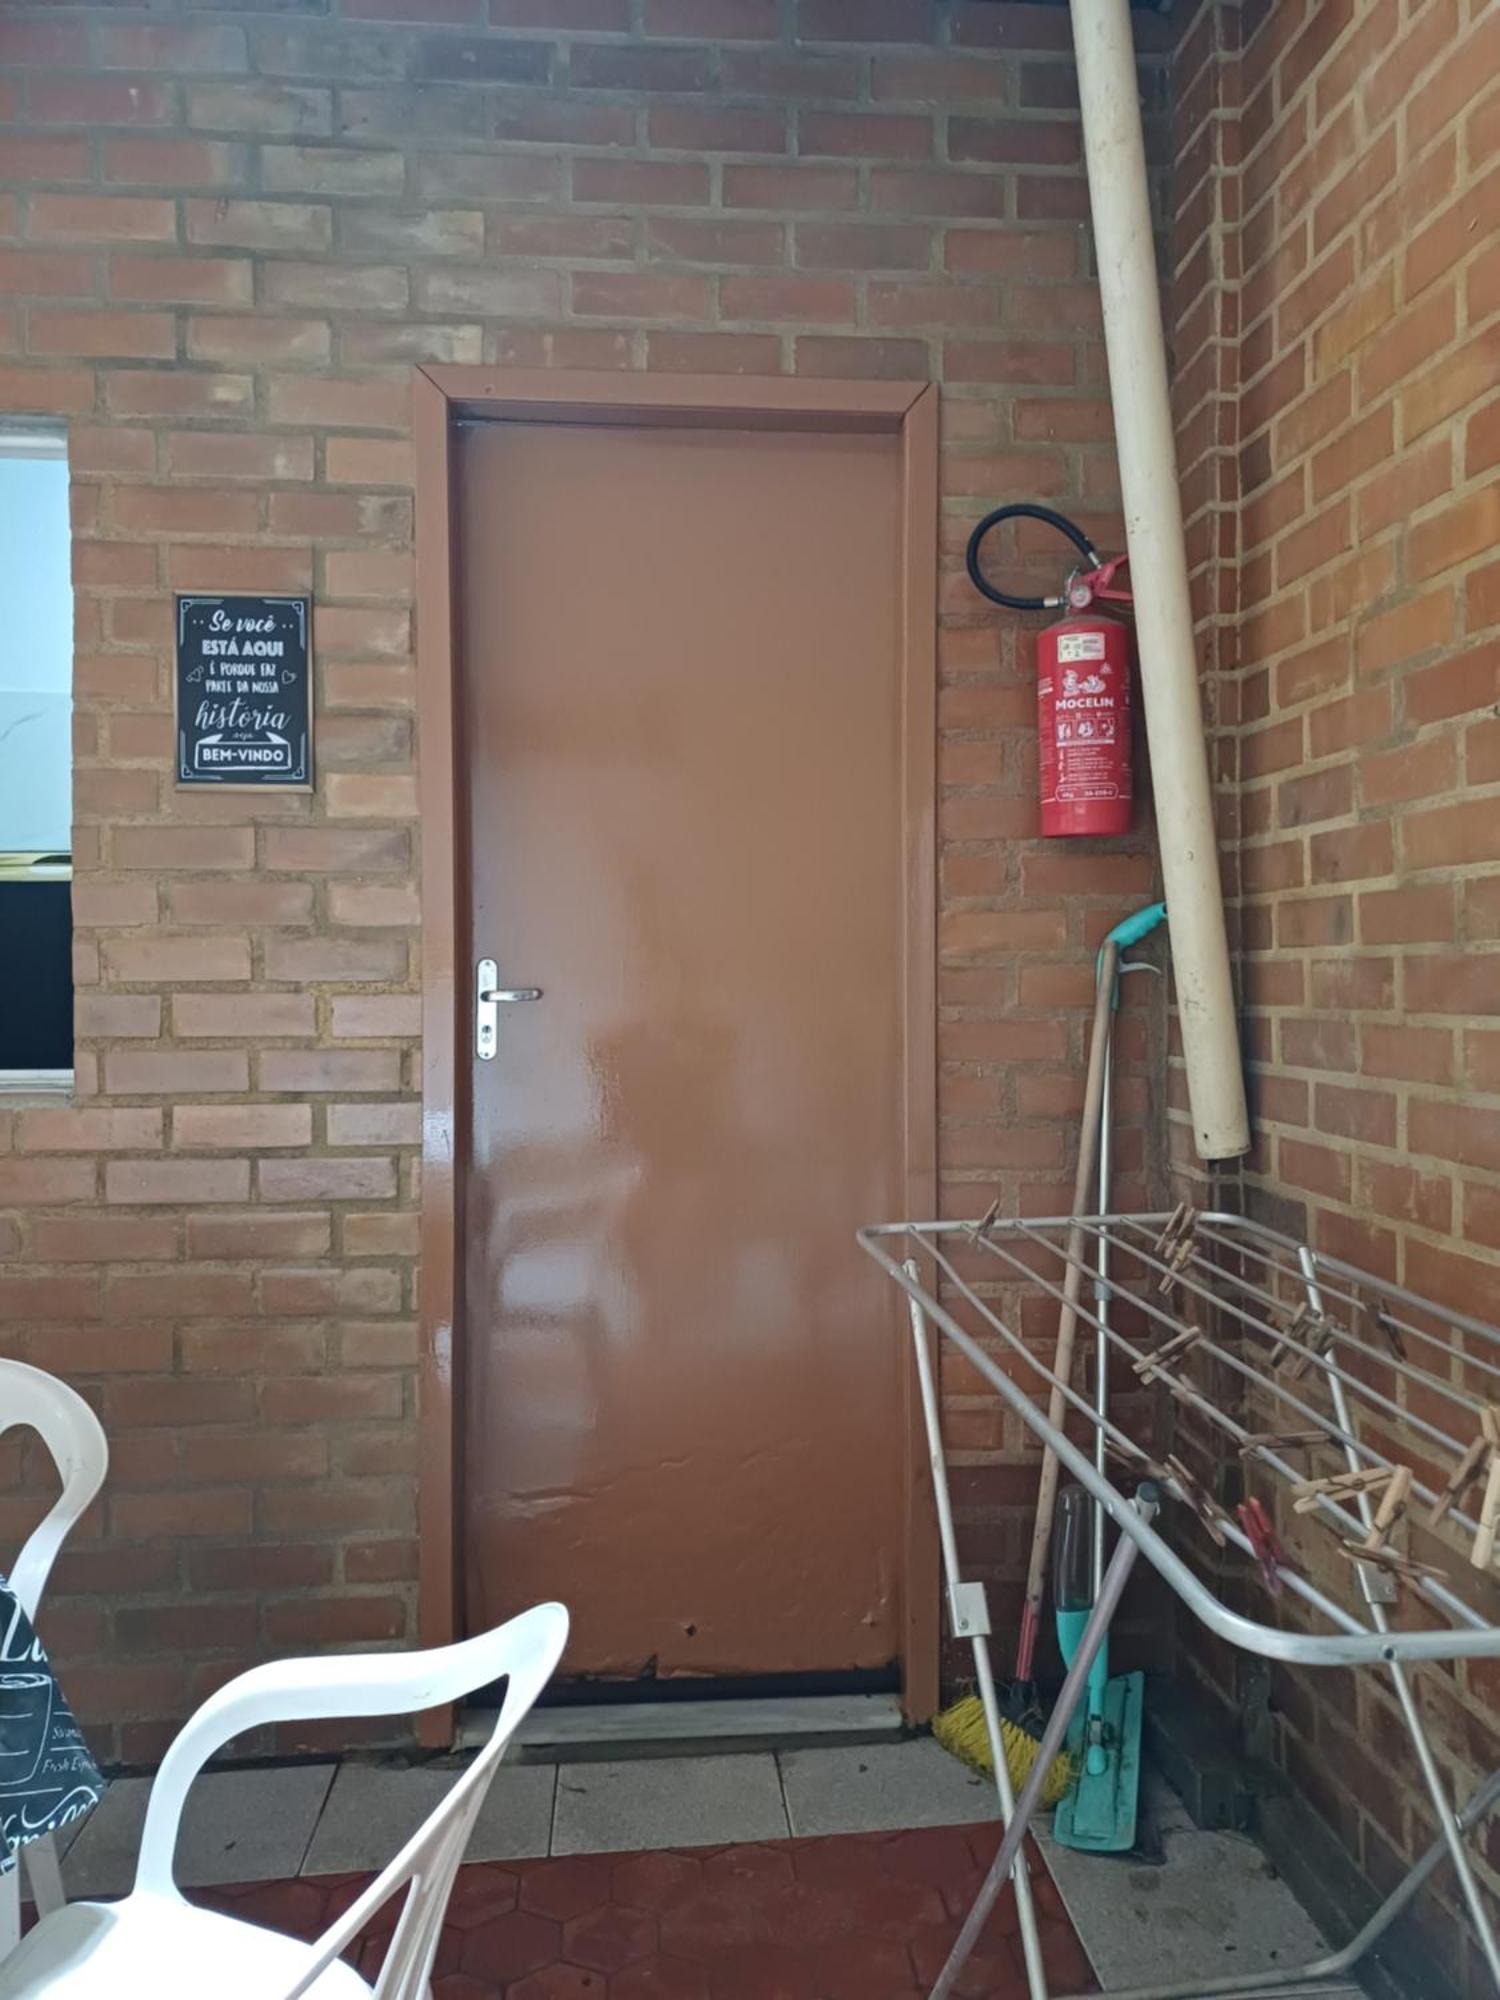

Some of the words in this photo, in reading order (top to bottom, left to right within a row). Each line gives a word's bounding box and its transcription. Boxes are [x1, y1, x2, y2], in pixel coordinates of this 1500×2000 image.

[208, 609, 233, 632] Se
[236, 615, 277, 633] você
[202, 637, 239, 656] ESTÁ
[242, 640, 285, 657] AQUI
[209, 660, 216, 676] É
[220, 662, 256, 676] PORQUE
[260, 663, 277, 677] FAZ
[205, 679, 232, 693] PARTE
[236, 681, 249, 693] DA
[252, 681, 280, 694] NOSSA
[1055, 697, 1115, 711] MOCELIN
[194, 697, 292, 731] história
[202, 748, 284, 762] BEM-VINDO
